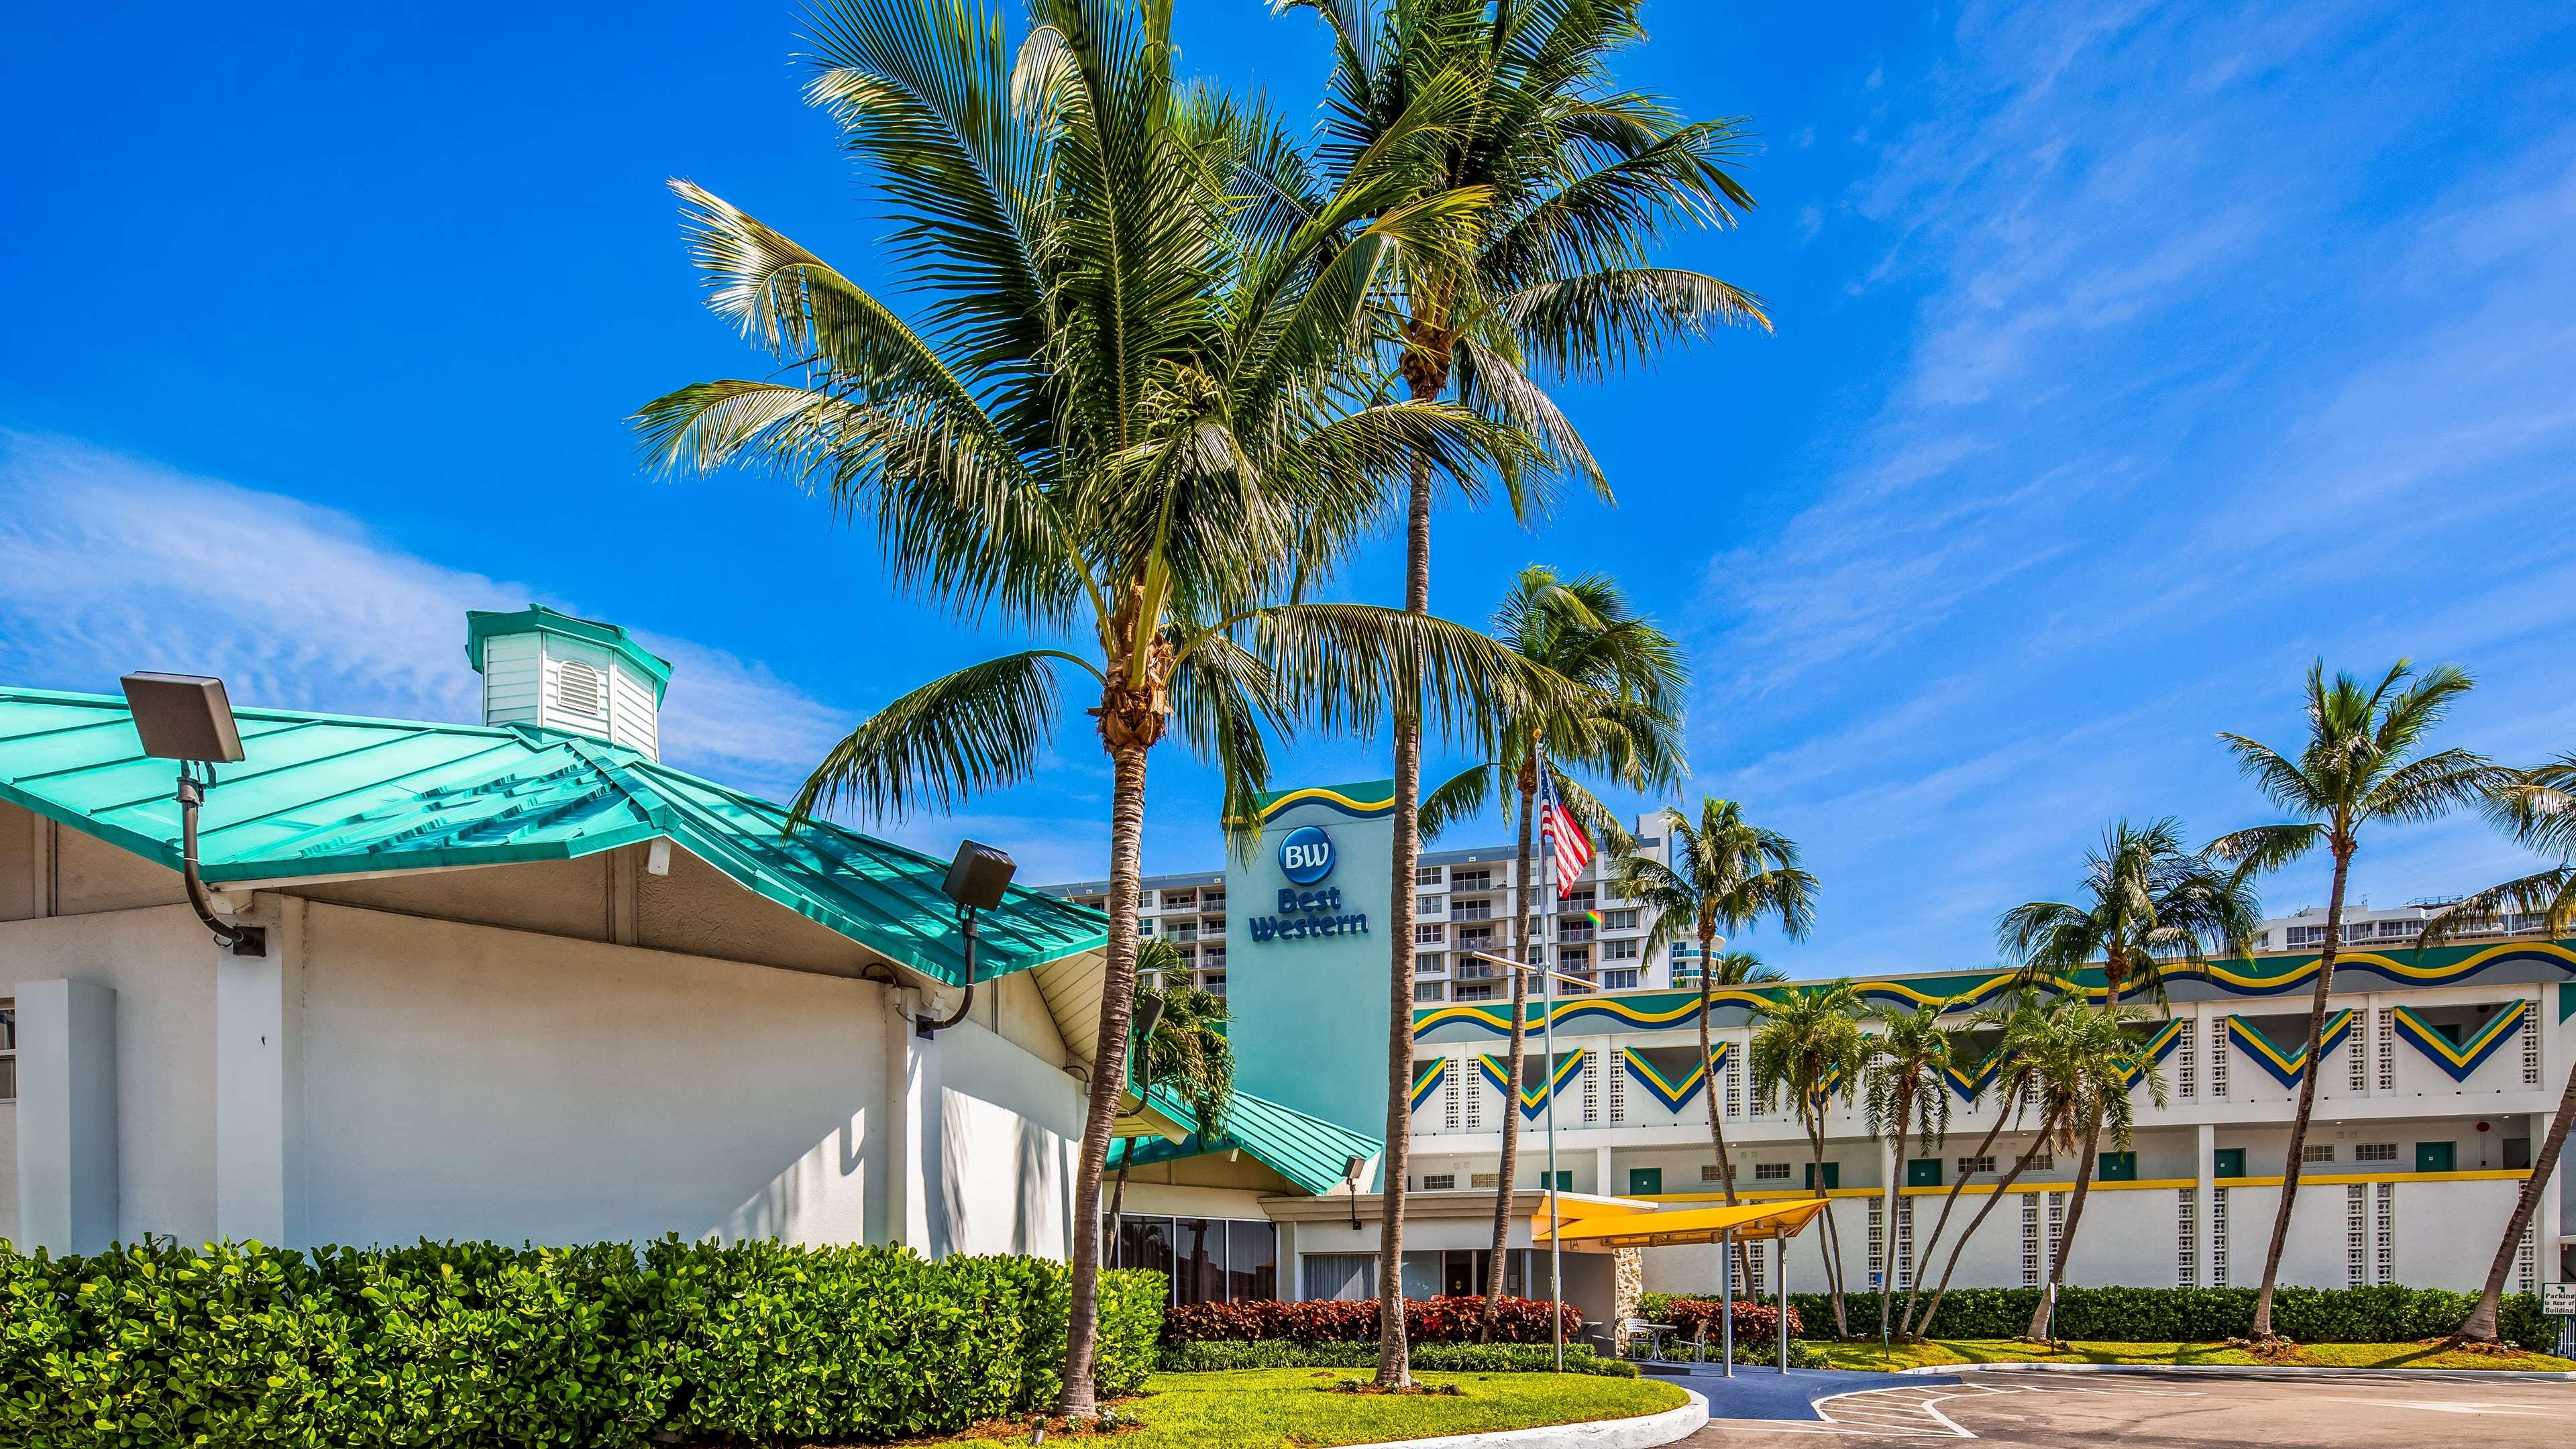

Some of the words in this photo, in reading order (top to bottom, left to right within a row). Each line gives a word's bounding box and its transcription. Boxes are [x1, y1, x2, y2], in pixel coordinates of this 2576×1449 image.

[1285, 843, 1329, 869] BW
[1277, 886, 1341, 914] Best
[1249, 913, 1369, 943] Western
